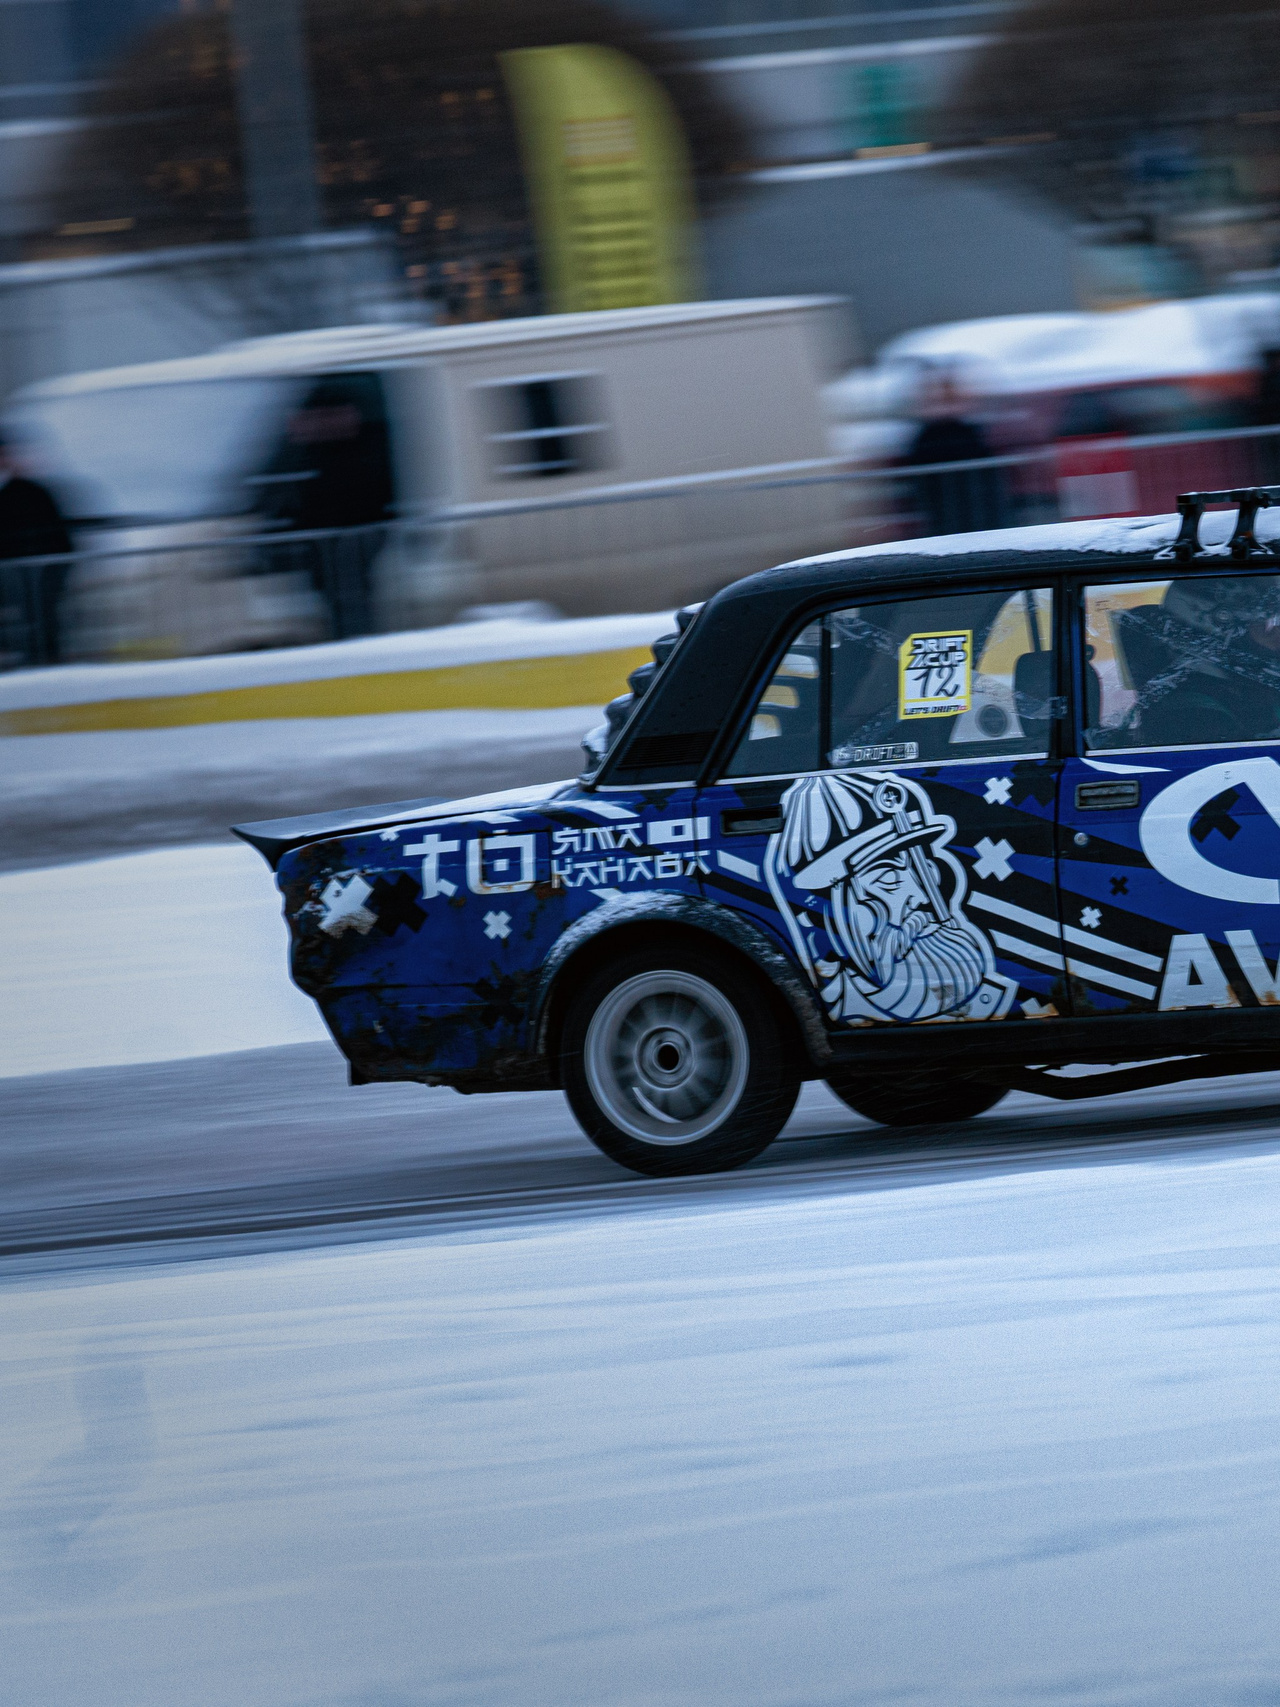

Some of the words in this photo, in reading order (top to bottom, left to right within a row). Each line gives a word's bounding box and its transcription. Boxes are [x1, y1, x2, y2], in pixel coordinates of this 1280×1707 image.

[911, 636, 967, 654] DRIFT
[913, 667, 961, 698] 12
[854, 746, 893, 762] DRIFT
[551, 850, 712, 889] КАНАВА
